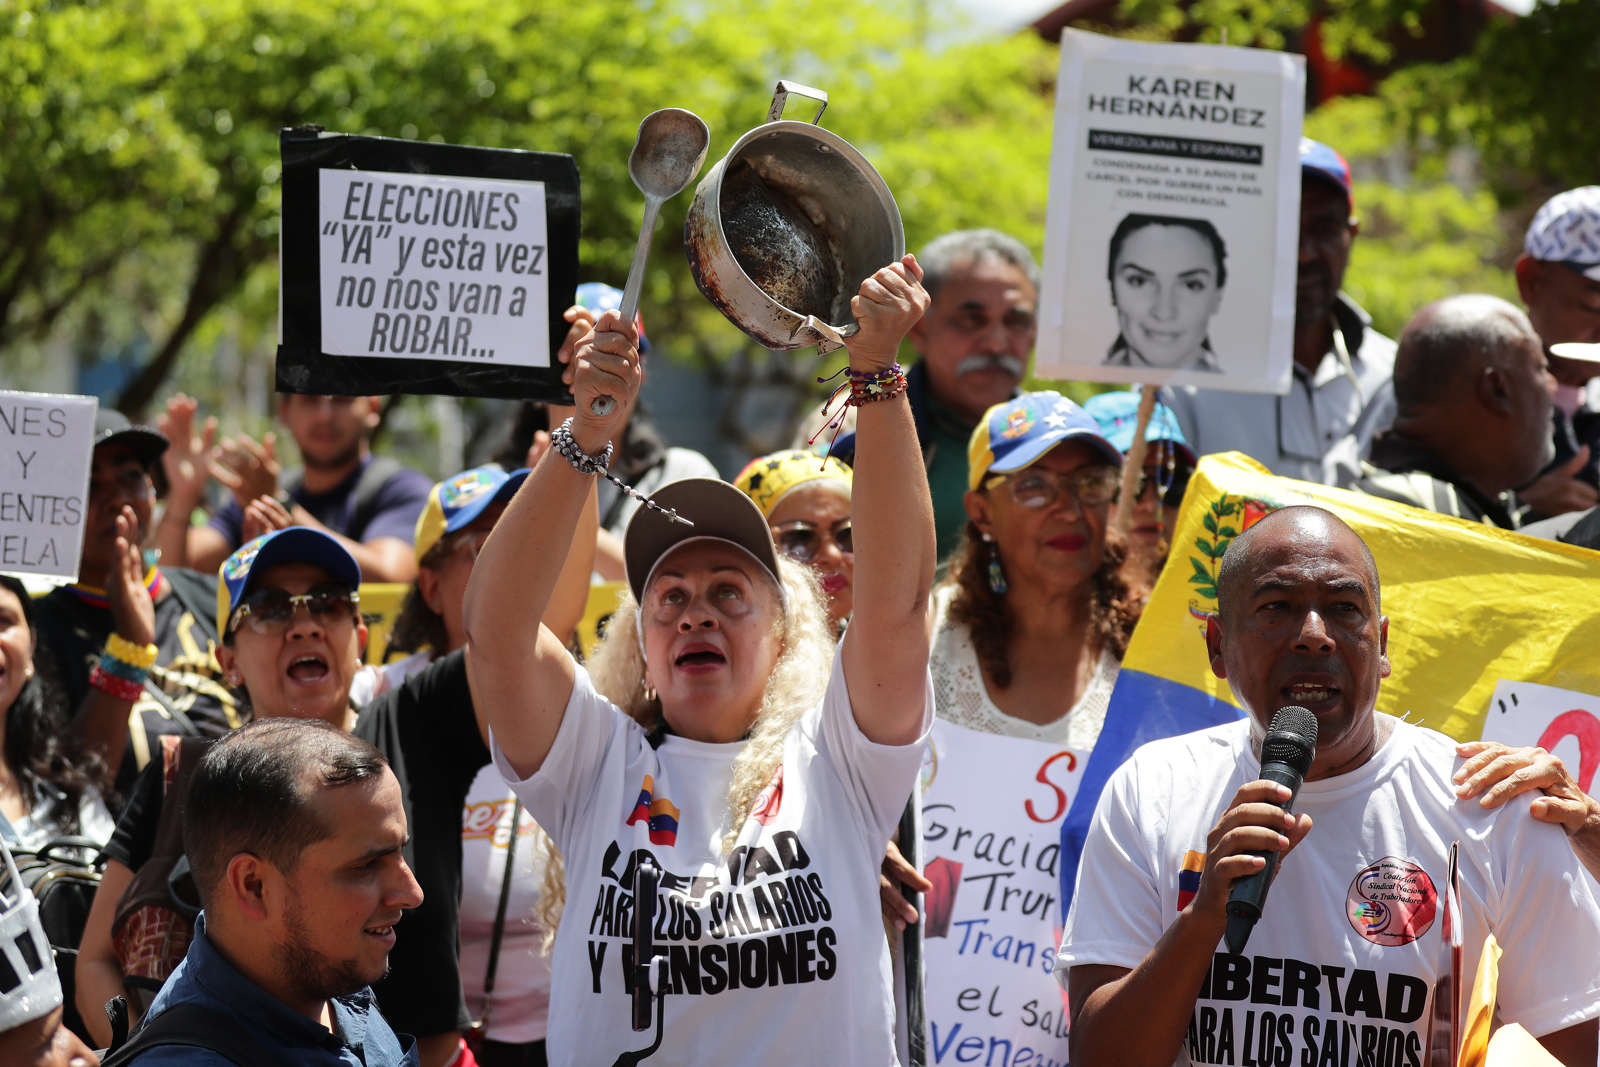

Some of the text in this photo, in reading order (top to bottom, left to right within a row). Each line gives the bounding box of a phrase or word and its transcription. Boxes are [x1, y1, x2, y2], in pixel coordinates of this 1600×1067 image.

[1128, 75, 1235, 101] KAREN
[1088, 94, 1266, 128] HERNÁNDEZ
[1092, 133, 1261, 160] VENEZOLANA Y ESPAÑOLA
[1093, 158, 1257, 181] CONDENADA A 30 AÑOS DE
[1136, 176, 1161, 186] POR
[1165, 178, 1213, 191] QUERER
[1216, 183, 1233, 192] UN
[343, 181, 520, 231] ELECCIONES
[1117, 188, 1143, 199] CON
[322, 221, 546, 276] “YA” y esta vez
[336, 275, 527, 317] no nos van a
[368, 312, 495, 358] ROBAR...
[17, 451, 37, 480] Y
[1, 492, 82, 526] ENTES
[0, 534, 60, 566] ELA
[1368, 882, 1429, 895] Sindical Nacional
[589, 872, 833, 942] PAR LOS SALARIOS
[588, 940, 608, 994] Y
[957, 985, 1003, 1017] el
[1183, 1006, 1235, 1066] ARA
[1242, 1010, 1294, 1067] LOS
